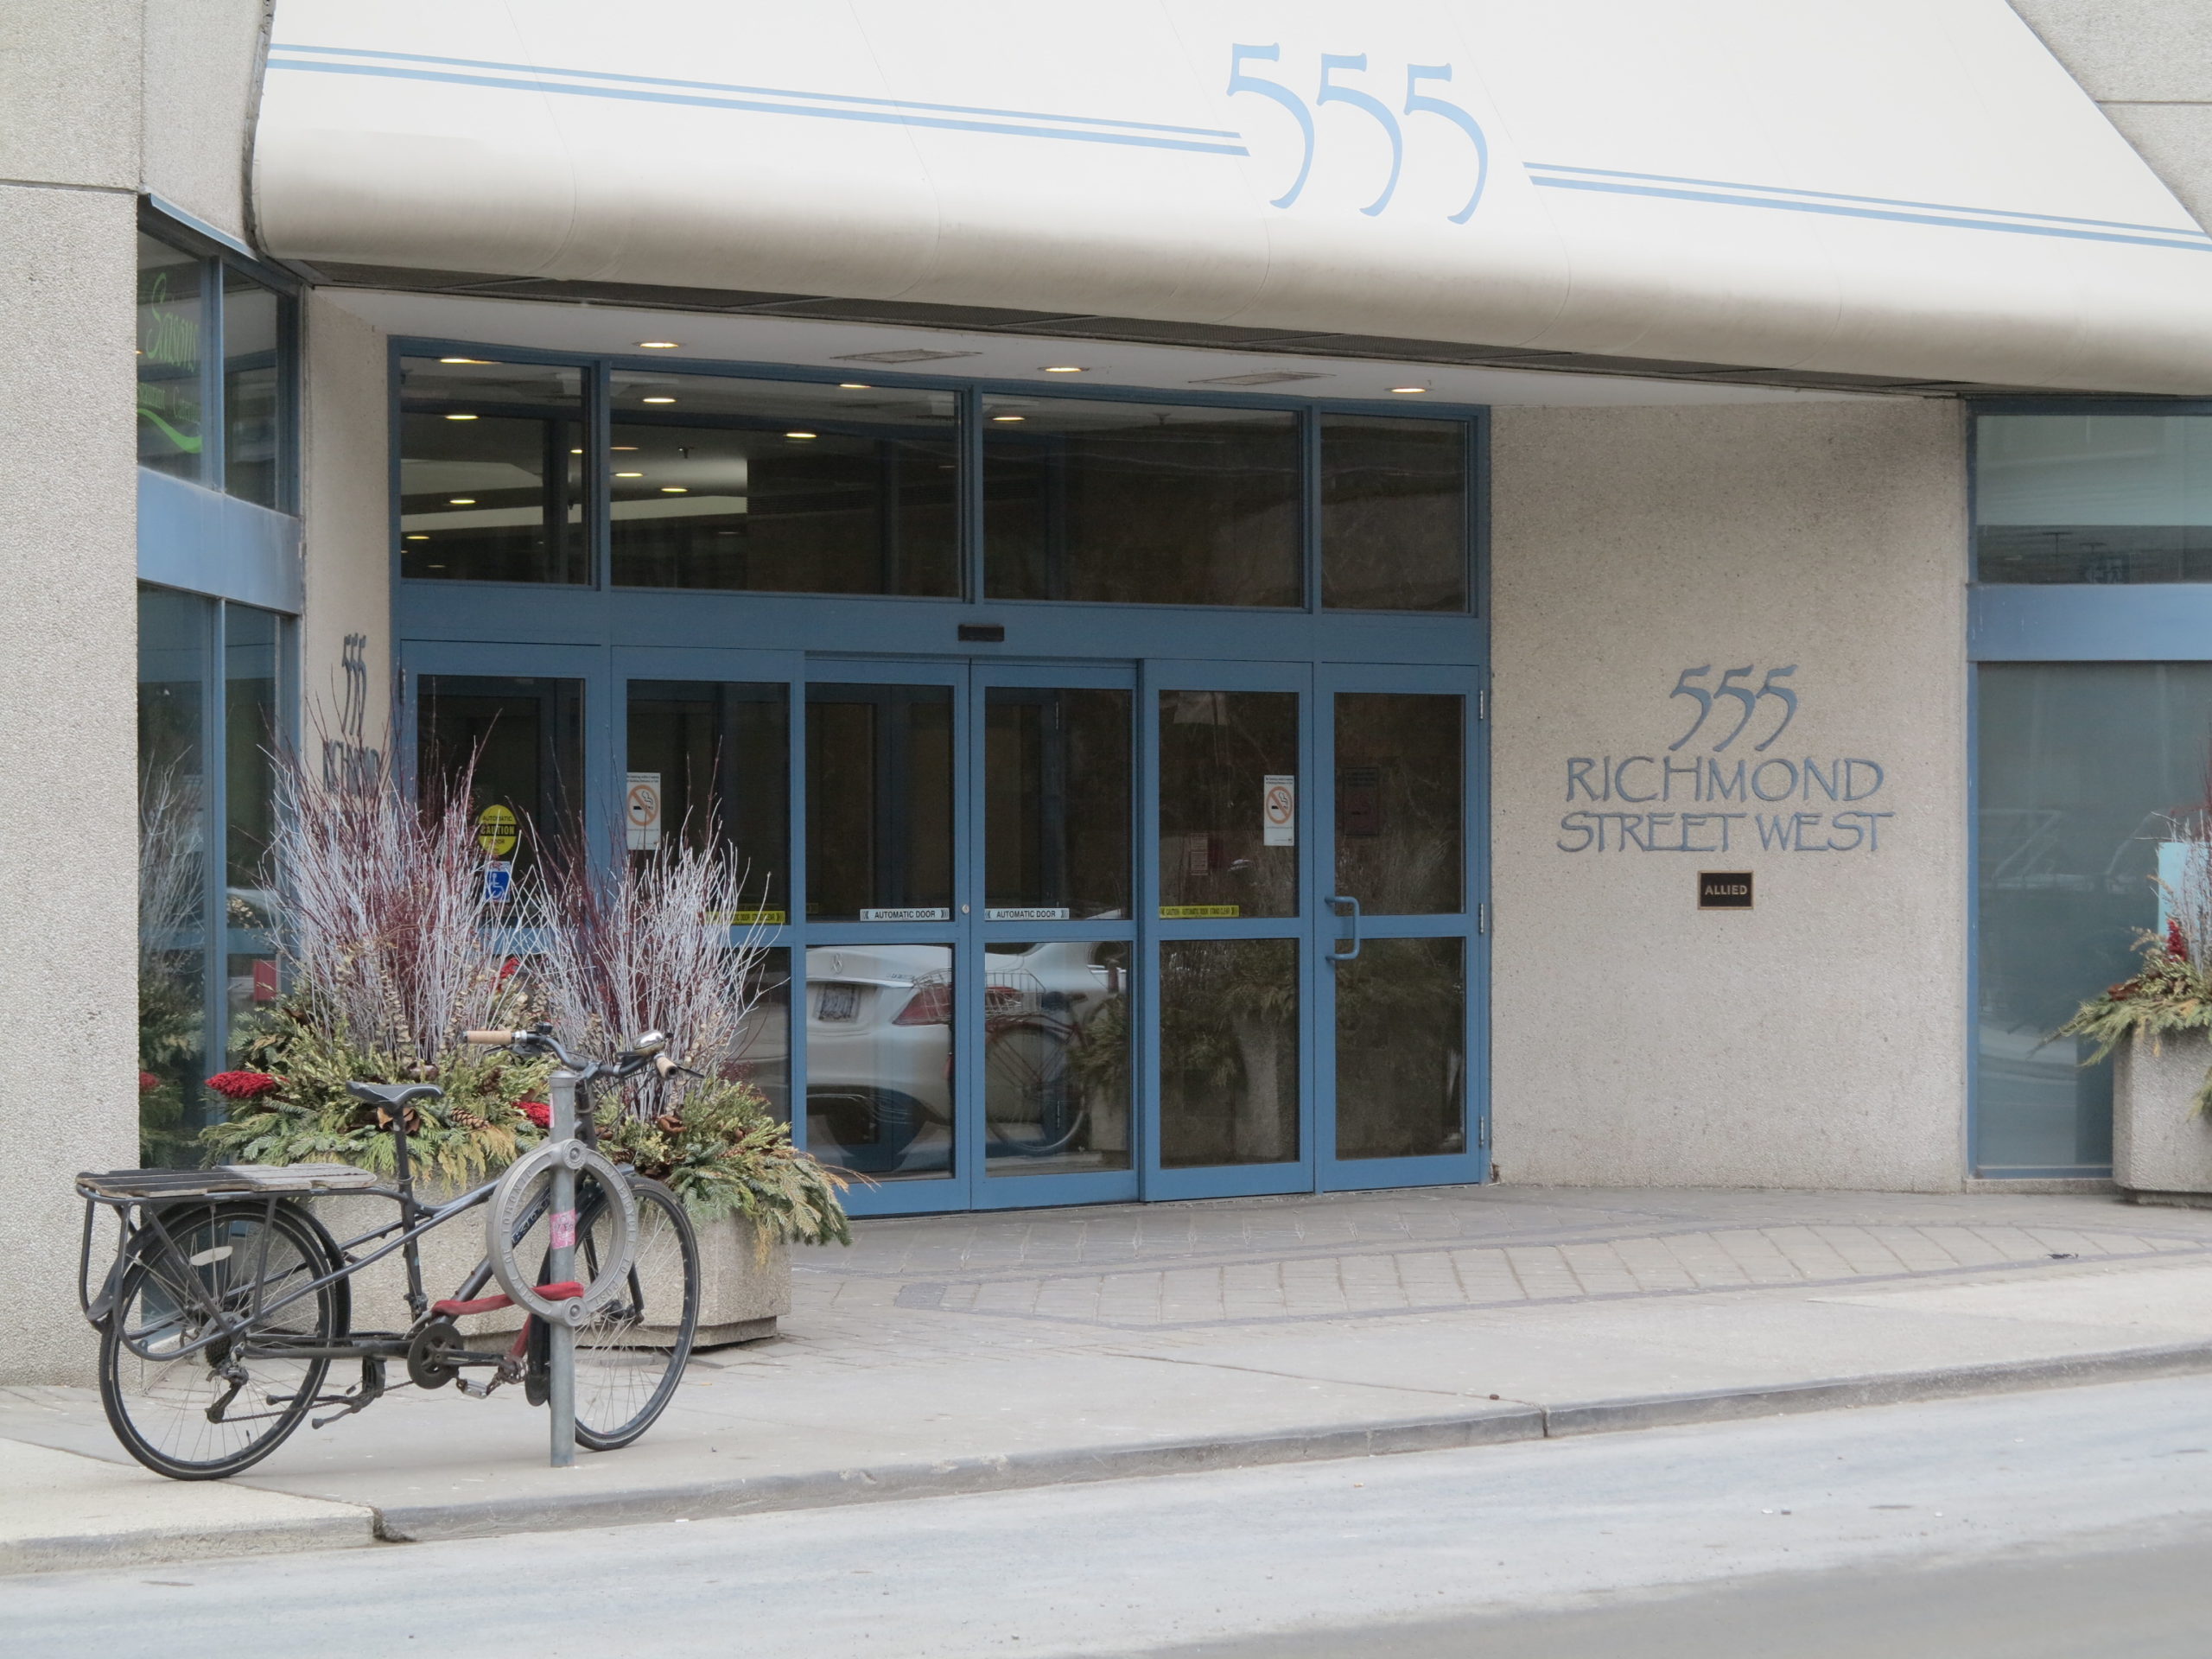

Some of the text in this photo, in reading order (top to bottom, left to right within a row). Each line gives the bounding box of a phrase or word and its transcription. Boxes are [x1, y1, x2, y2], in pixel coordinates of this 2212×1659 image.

[1226, 41, 1488, 225] 555
[1669, 664, 1798, 753] 555
[1566, 755, 1885, 803] RICHMOND
[480, 824, 515, 836] CAUTION
[1556, 810, 1896, 853] STREET WEST
[1704, 885, 1748, 896] ALLIED
[874, 910, 936, 919] AUTOMATIC DOOR
[996, 910, 1056, 918] AUTOMATIC DOOR
